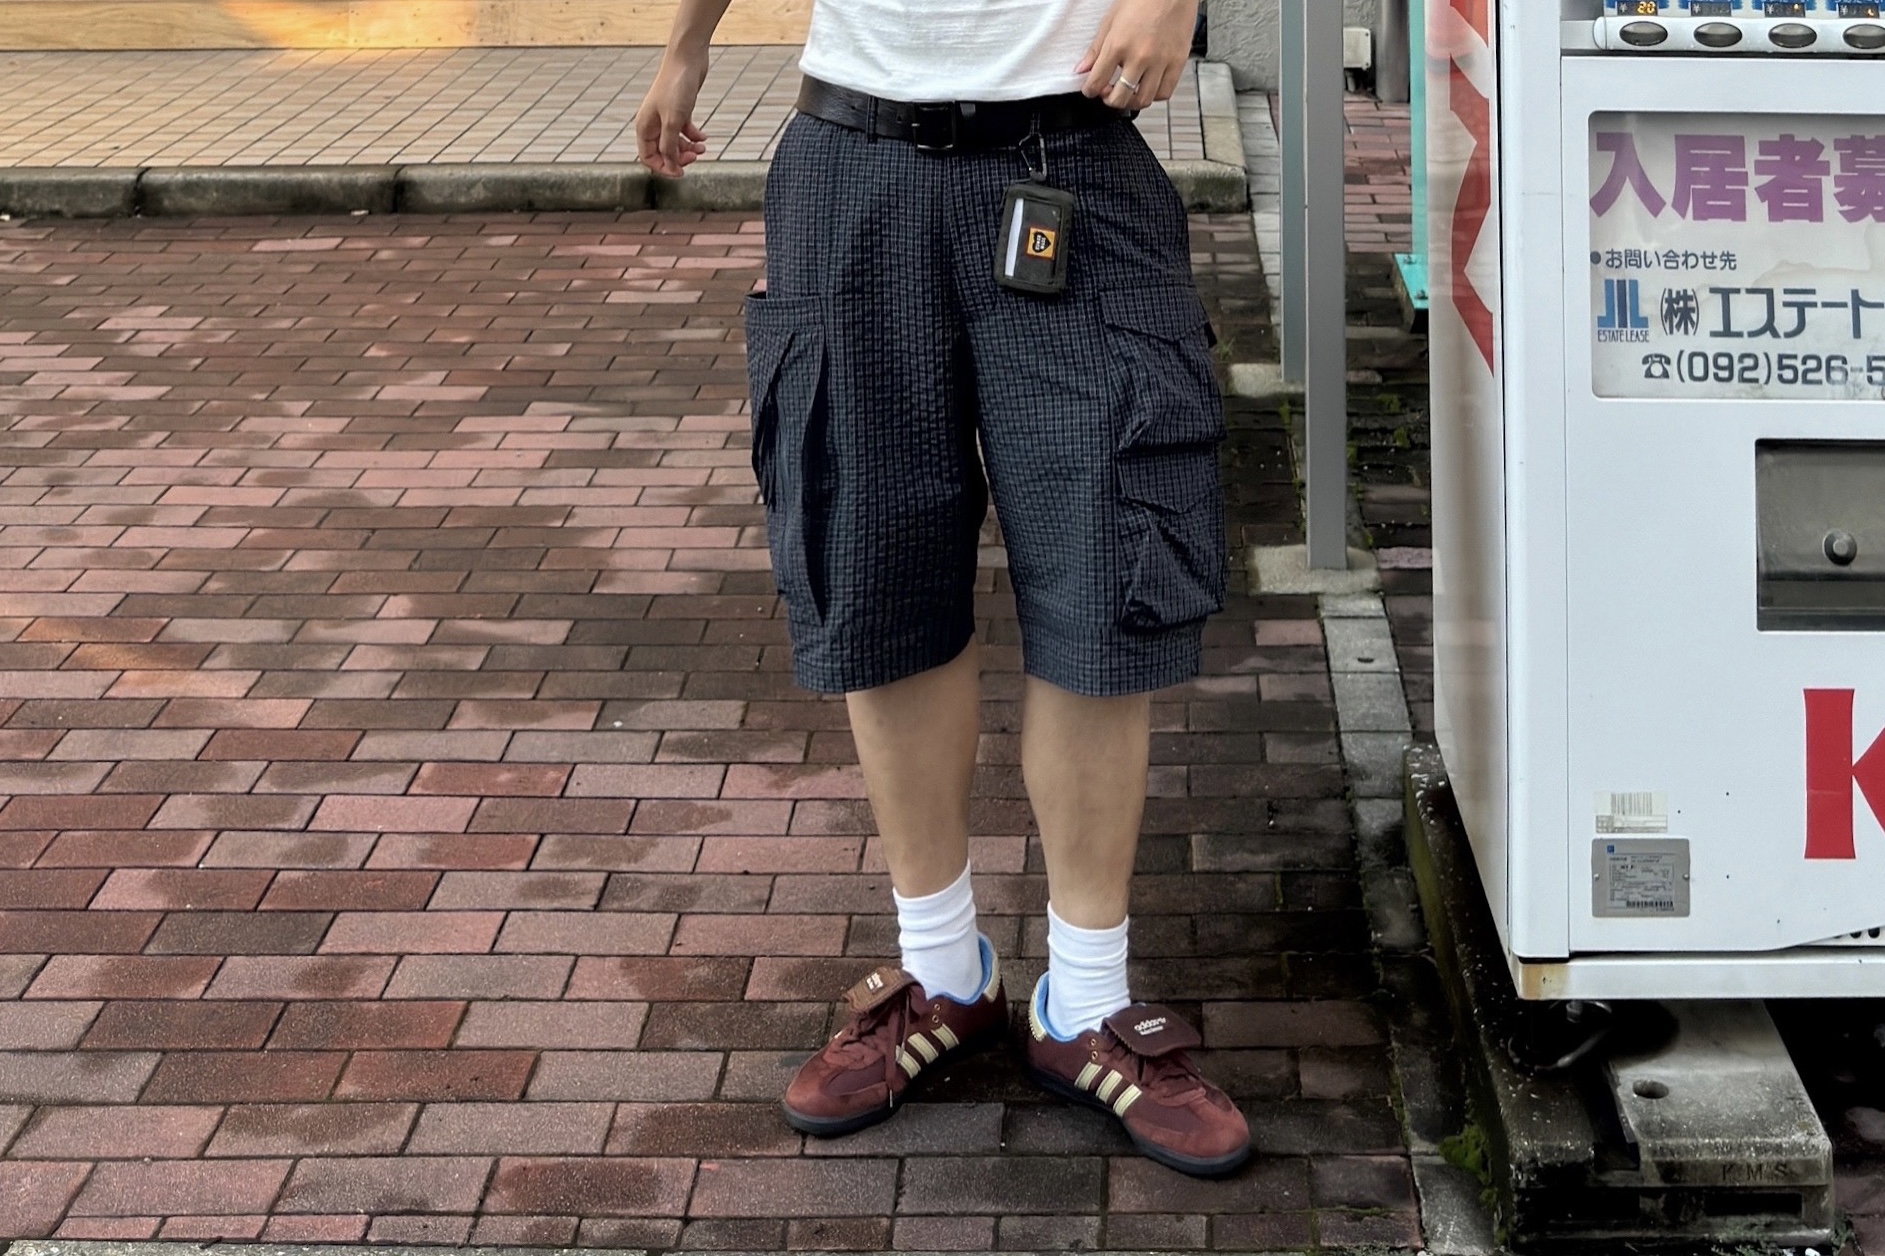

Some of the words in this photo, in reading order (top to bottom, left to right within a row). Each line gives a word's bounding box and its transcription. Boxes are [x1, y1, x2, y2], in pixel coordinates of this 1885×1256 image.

[1590, 132, 1885, 223] 入居者募
[1605, 249, 1737, 271] お問い合わせ先
[1597, 330, 1625, 342] ESTATE
[1626, 330, 1650, 342] LEASE
